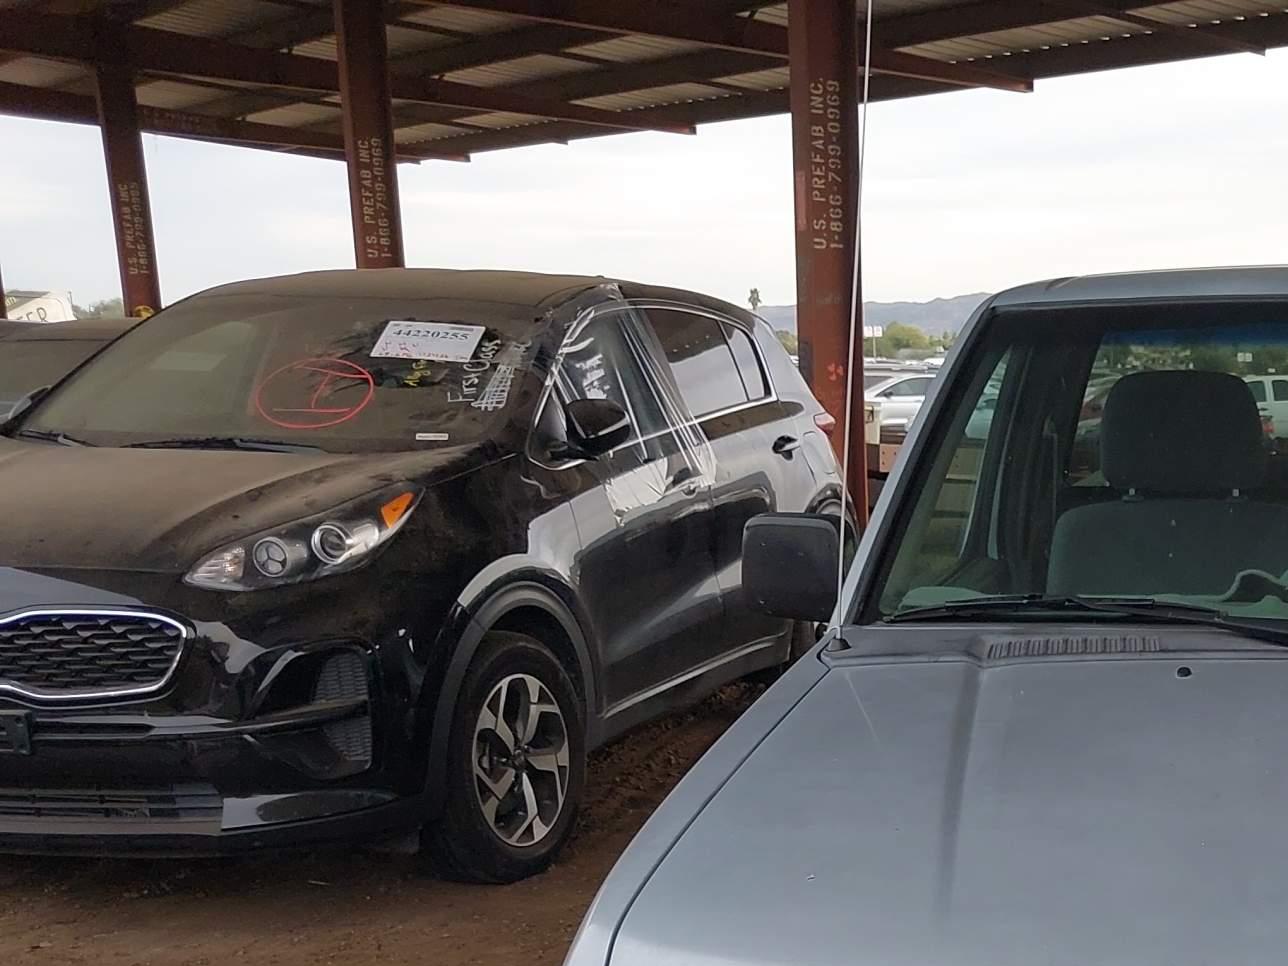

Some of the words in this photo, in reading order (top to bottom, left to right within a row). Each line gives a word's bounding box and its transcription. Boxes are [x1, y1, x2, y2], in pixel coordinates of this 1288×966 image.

[810, 77, 824, 114] INC.
[811, 125, 826, 202] PREFAB
[826, 79, 844, 249] 1-866-799-0969
[361, 169, 376, 224] PREFAB
[813, 213, 827, 249] U.S.
[392, 329, 471, 341] 44220255
